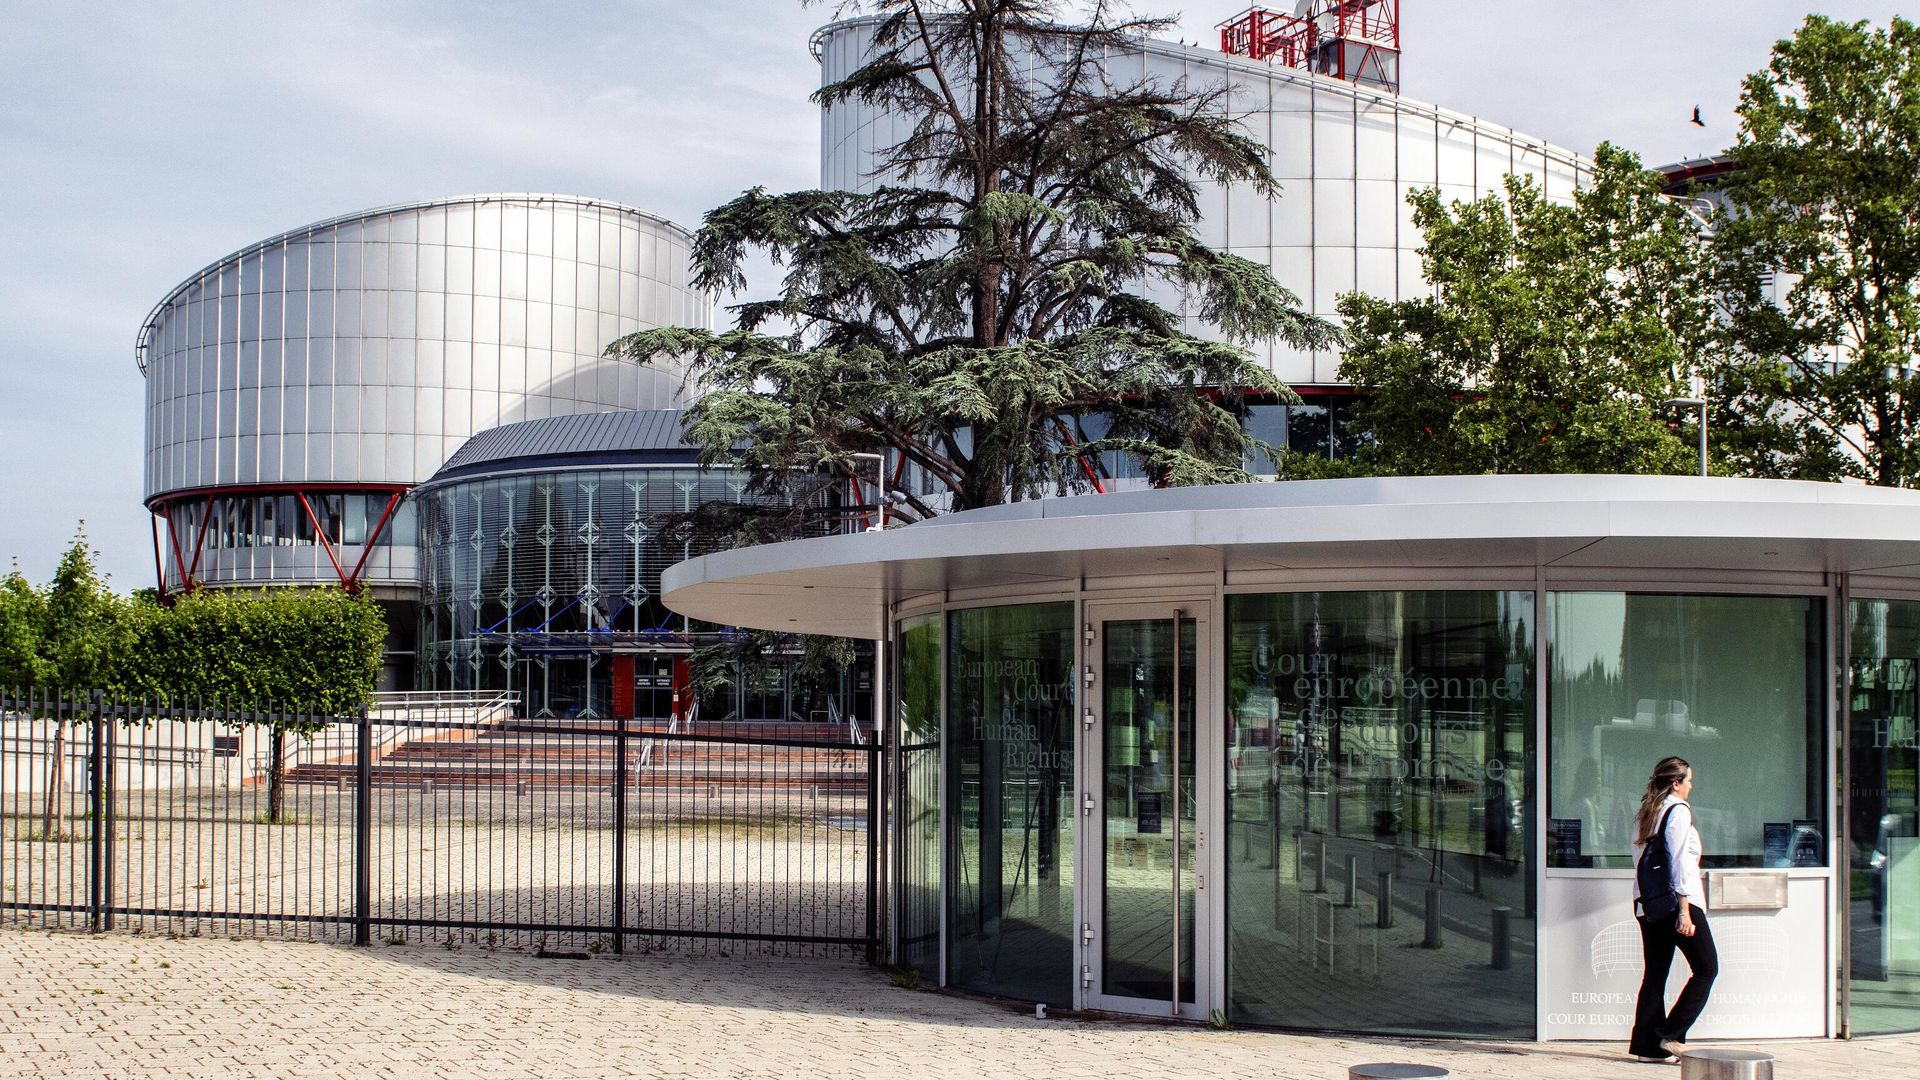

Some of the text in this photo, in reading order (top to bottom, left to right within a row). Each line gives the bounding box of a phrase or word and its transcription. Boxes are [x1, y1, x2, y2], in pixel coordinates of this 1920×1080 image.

[957, 654, 1037, 683] European
[1252, 645, 1337, 675] Cour
[1293, 667, 1510, 705] européenne
[1003, 700, 1019, 724] of
[1299, 697, 1358, 729] des
[972, 716, 1039, 741] Human
[1005, 742, 1072, 775] Rights
[1291, 748, 1332, 779] de
[1547, 1013, 1586, 1025] COUR
